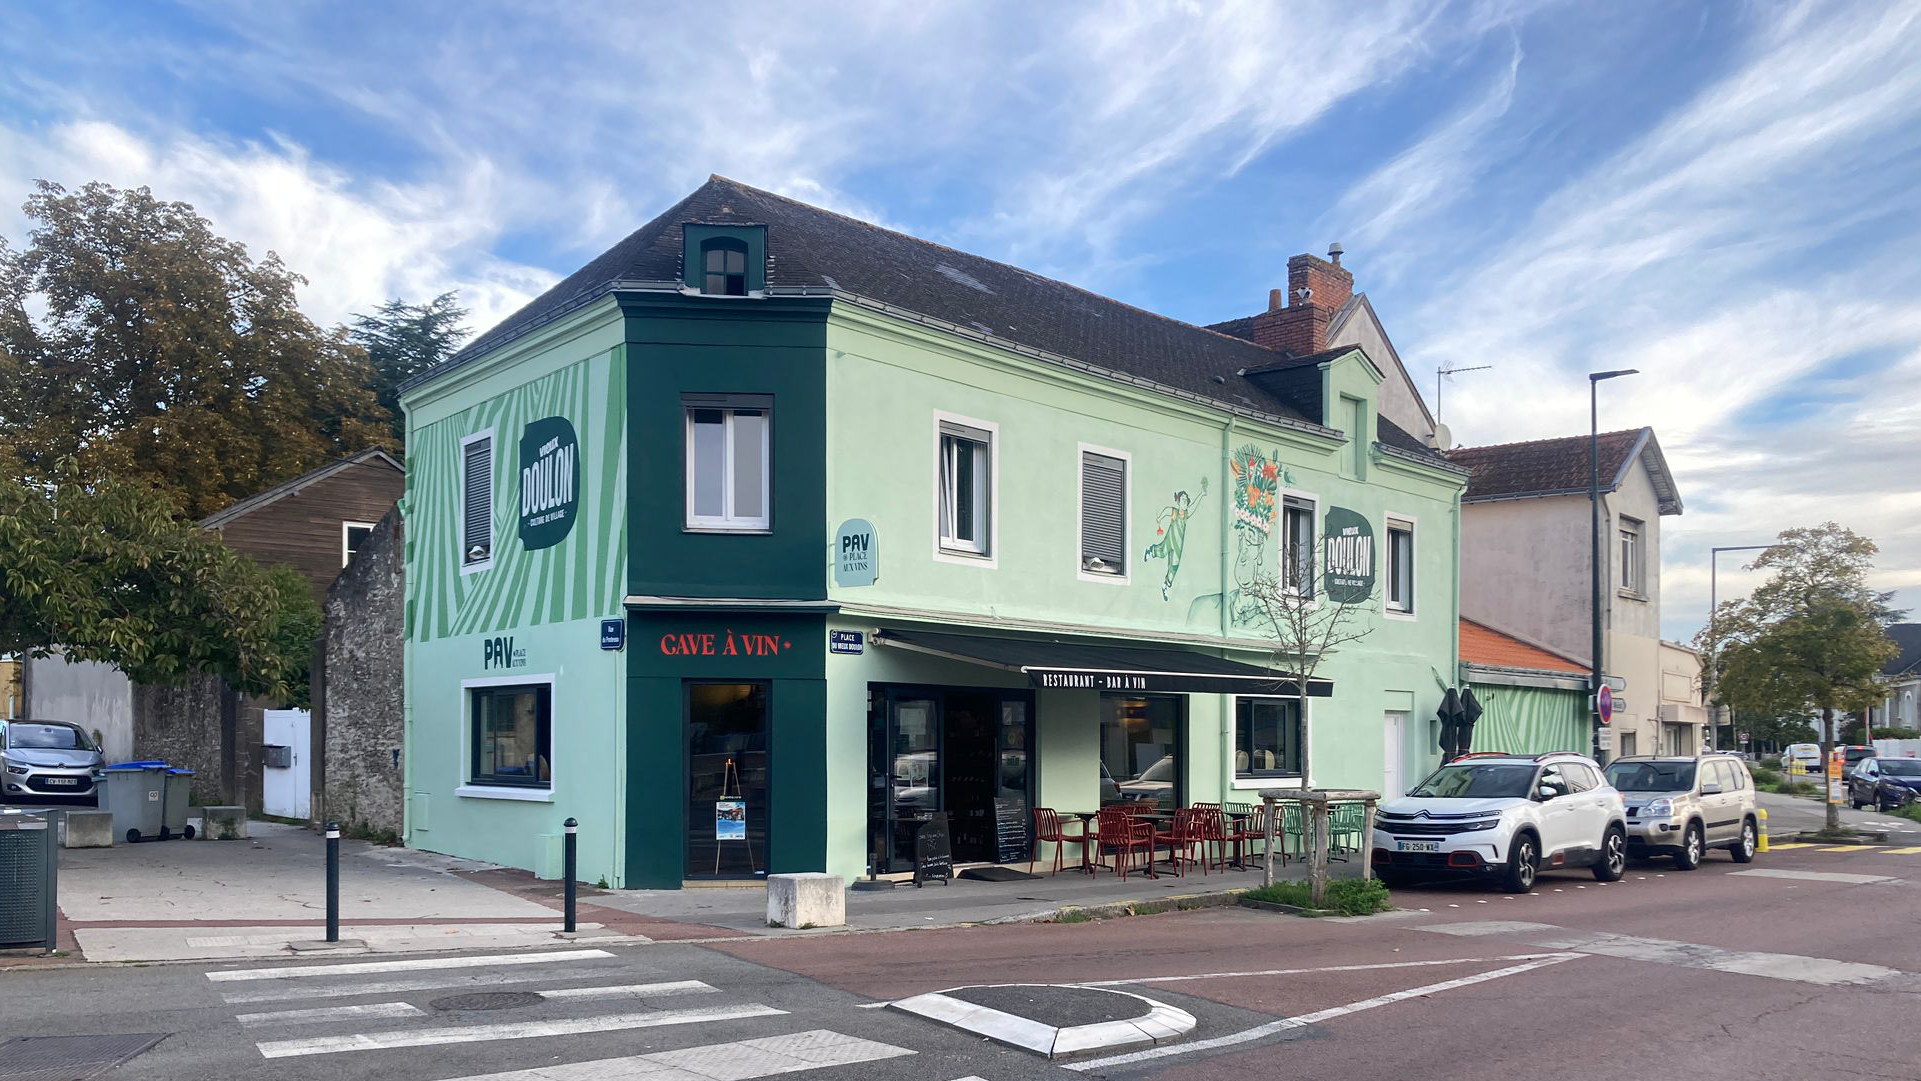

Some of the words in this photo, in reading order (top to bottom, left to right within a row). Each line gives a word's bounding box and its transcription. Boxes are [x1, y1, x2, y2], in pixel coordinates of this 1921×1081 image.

[522, 442, 574, 518] DOULON
[550, 509, 565, 521] VILLAGE
[843, 533, 870, 554] PAV
[850, 551, 868, 561] PLACE
[1327, 535, 1371, 577] DOULON
[660, 634, 715, 656] CAVE
[722, 628, 738, 656] À
[740, 634, 781, 656] VIN
[840, 633, 855, 642] PLACE
[484, 636, 514, 670] PAV
[1042, 673, 1095, 688] RESTAURANT
[1106, 676, 1121, 689] BAR
[1124, 674, 1130, 689] À
[1133, 676, 1146, 689] VIN
